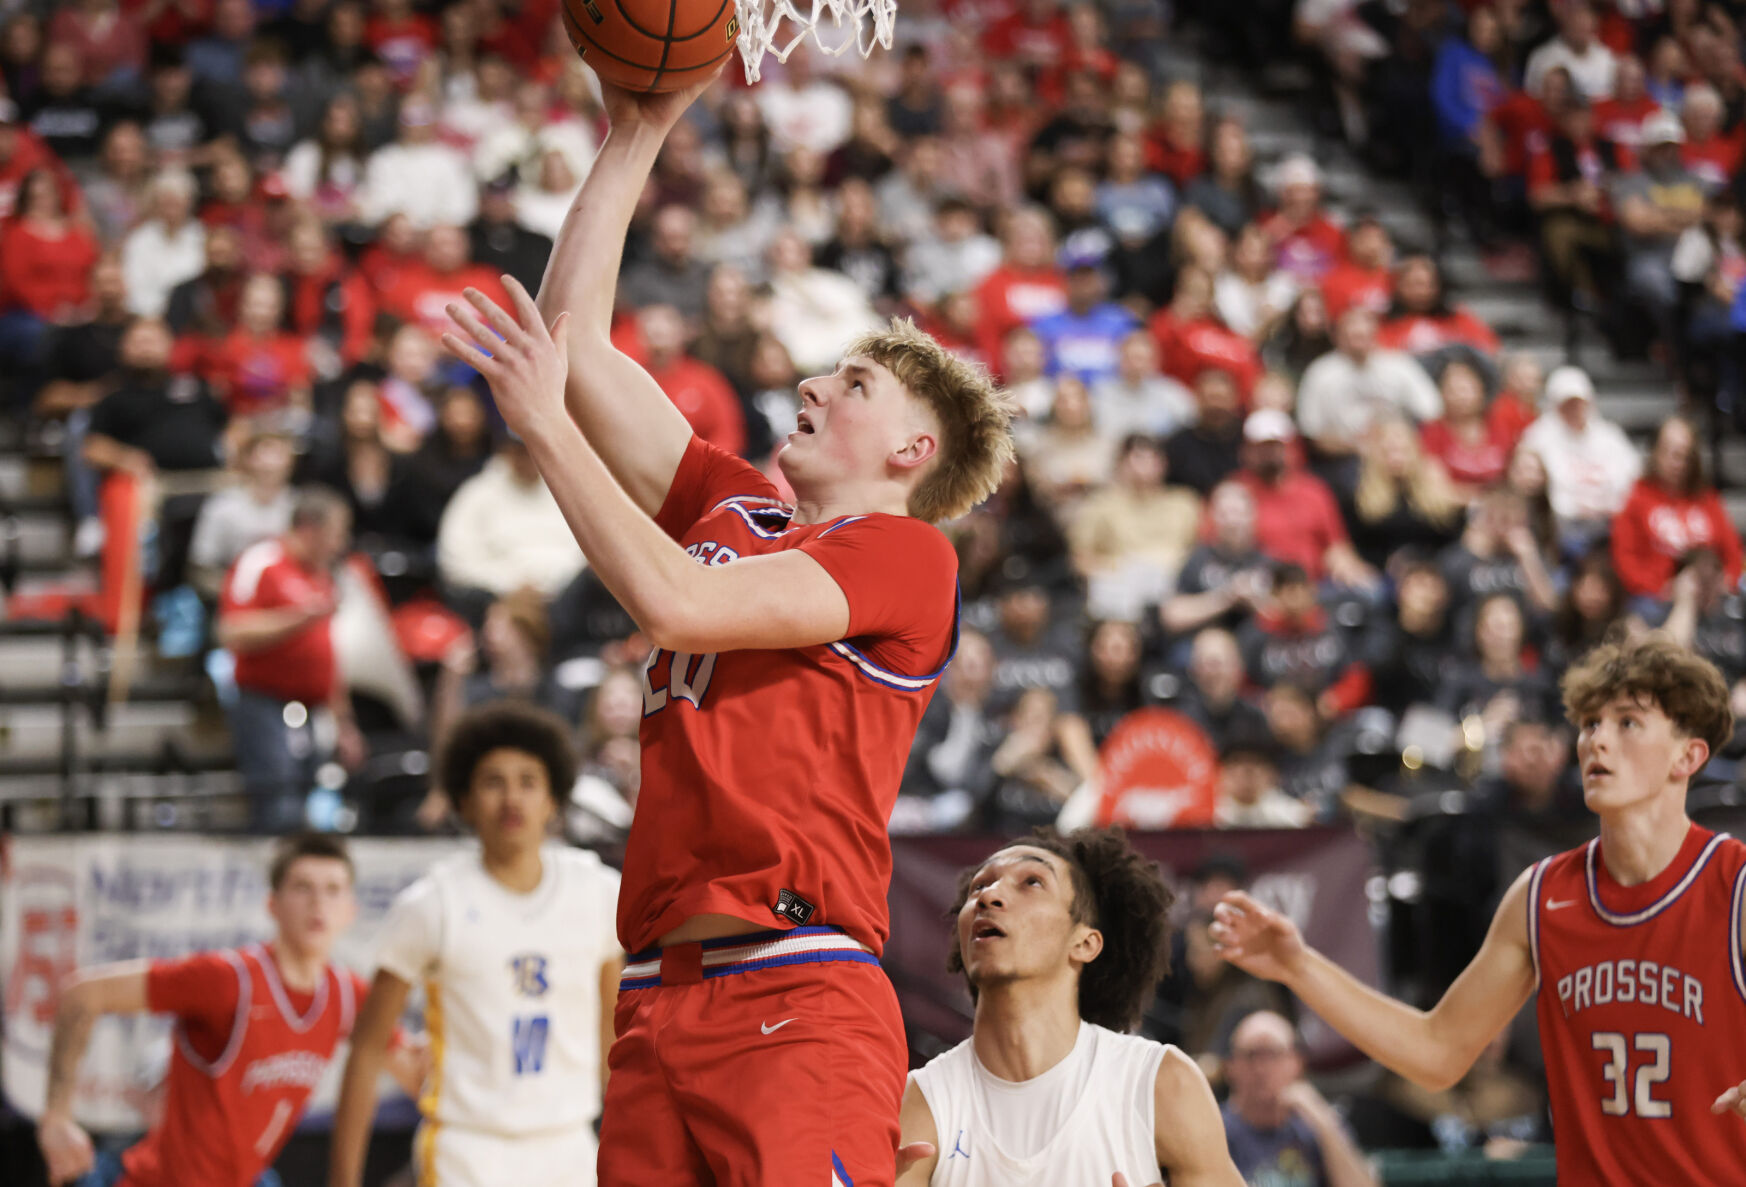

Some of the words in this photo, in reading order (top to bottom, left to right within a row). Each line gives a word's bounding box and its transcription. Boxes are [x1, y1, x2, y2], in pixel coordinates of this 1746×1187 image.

[790, 903, 804, 919] XL
[1557, 959, 1704, 1026] PROSSER
[1591, 1031, 1673, 1119] 32
